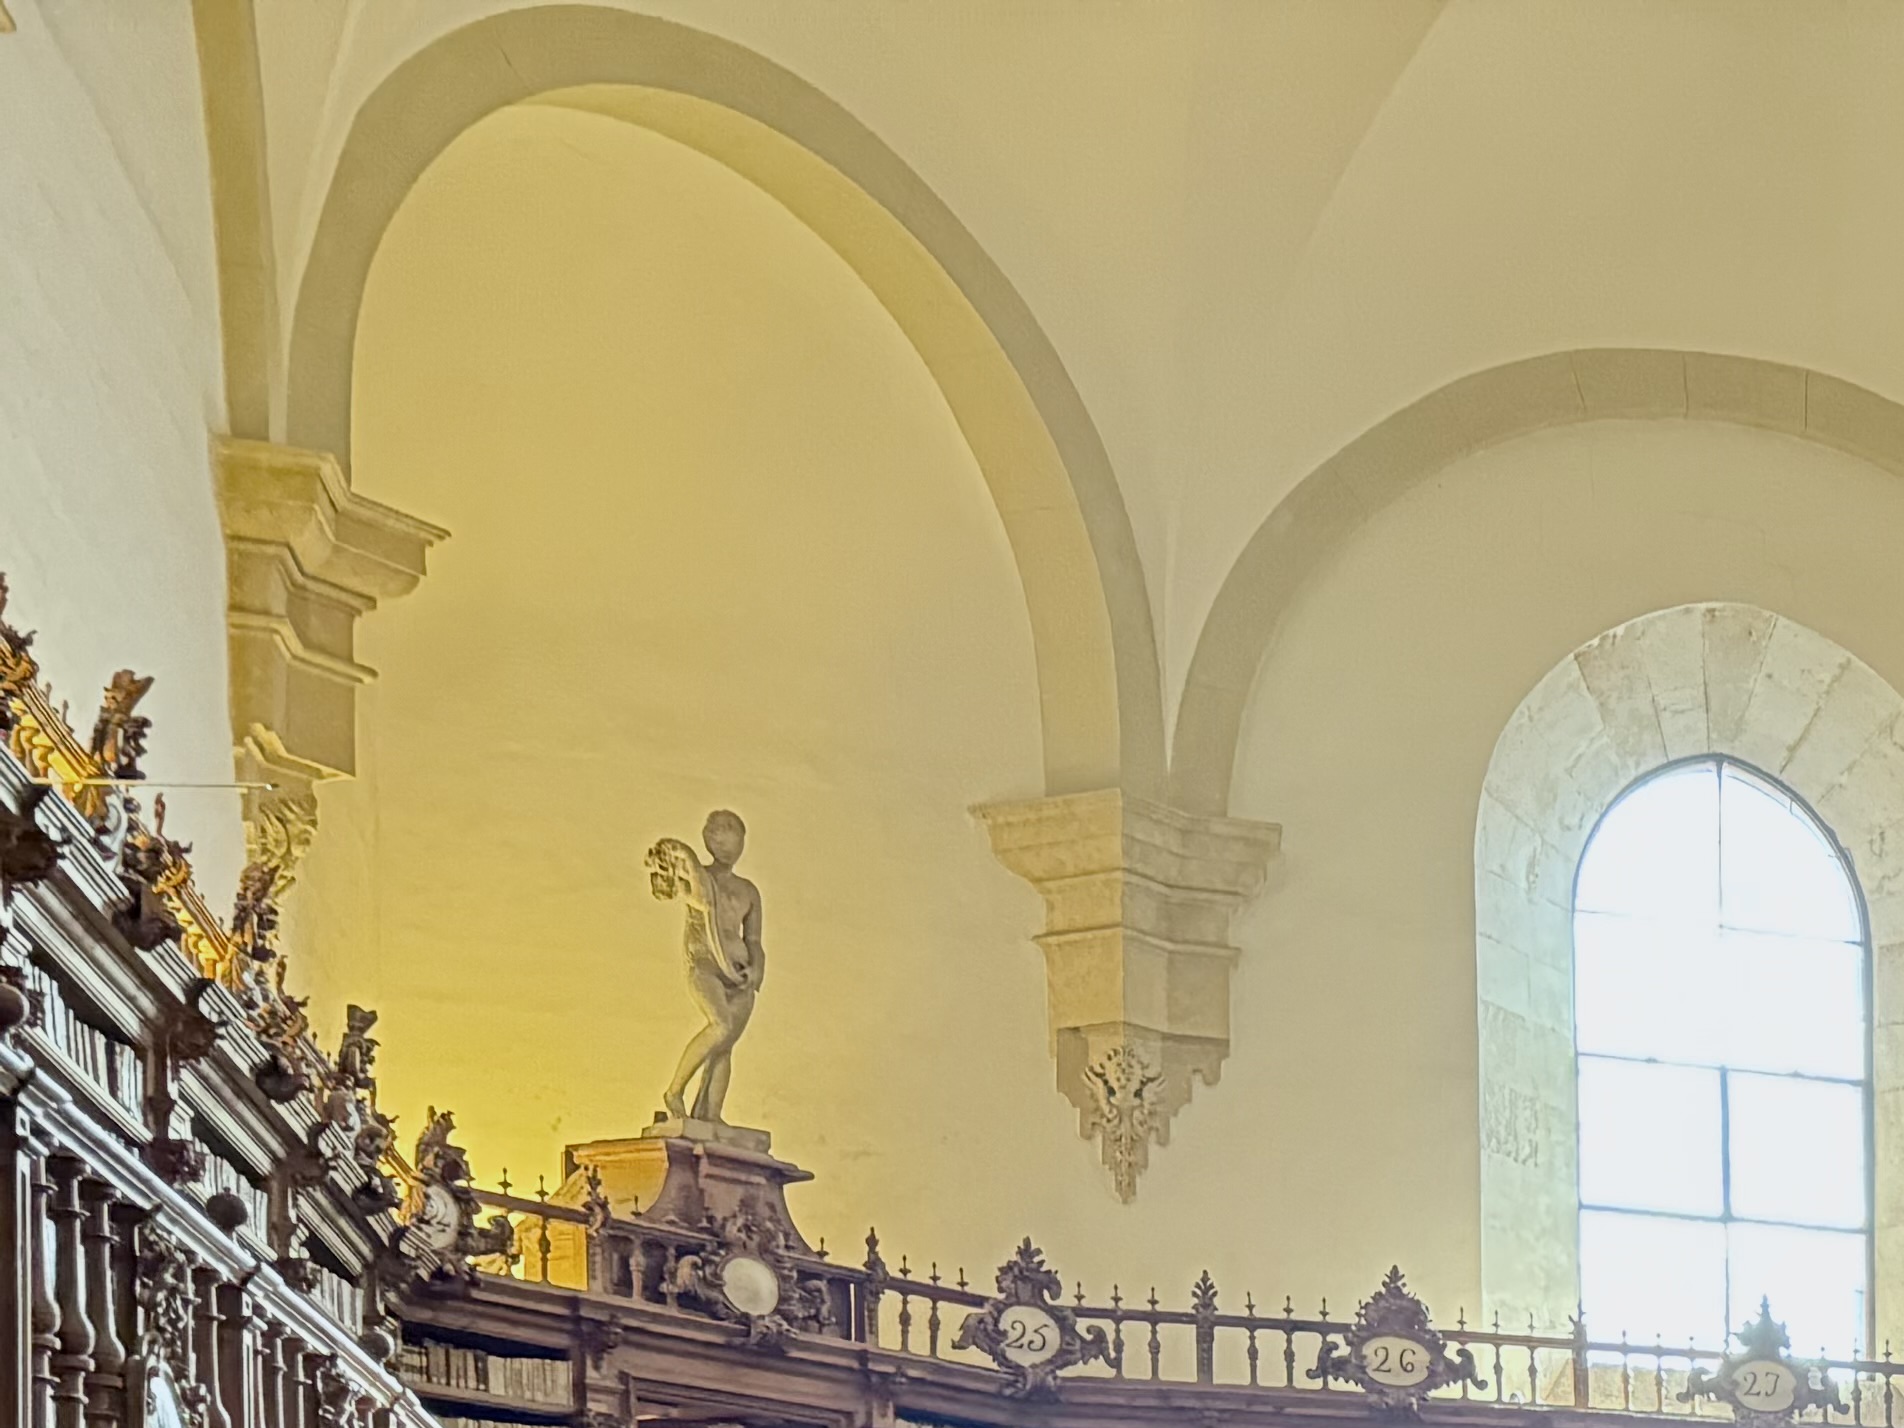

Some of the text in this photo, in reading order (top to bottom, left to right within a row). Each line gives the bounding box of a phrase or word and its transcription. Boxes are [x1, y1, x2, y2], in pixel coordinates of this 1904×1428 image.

[1005, 1319, 1050, 1352] 25
[1371, 1345, 1417, 1373] 26
[1743, 1371, 1780, 1397] 27
